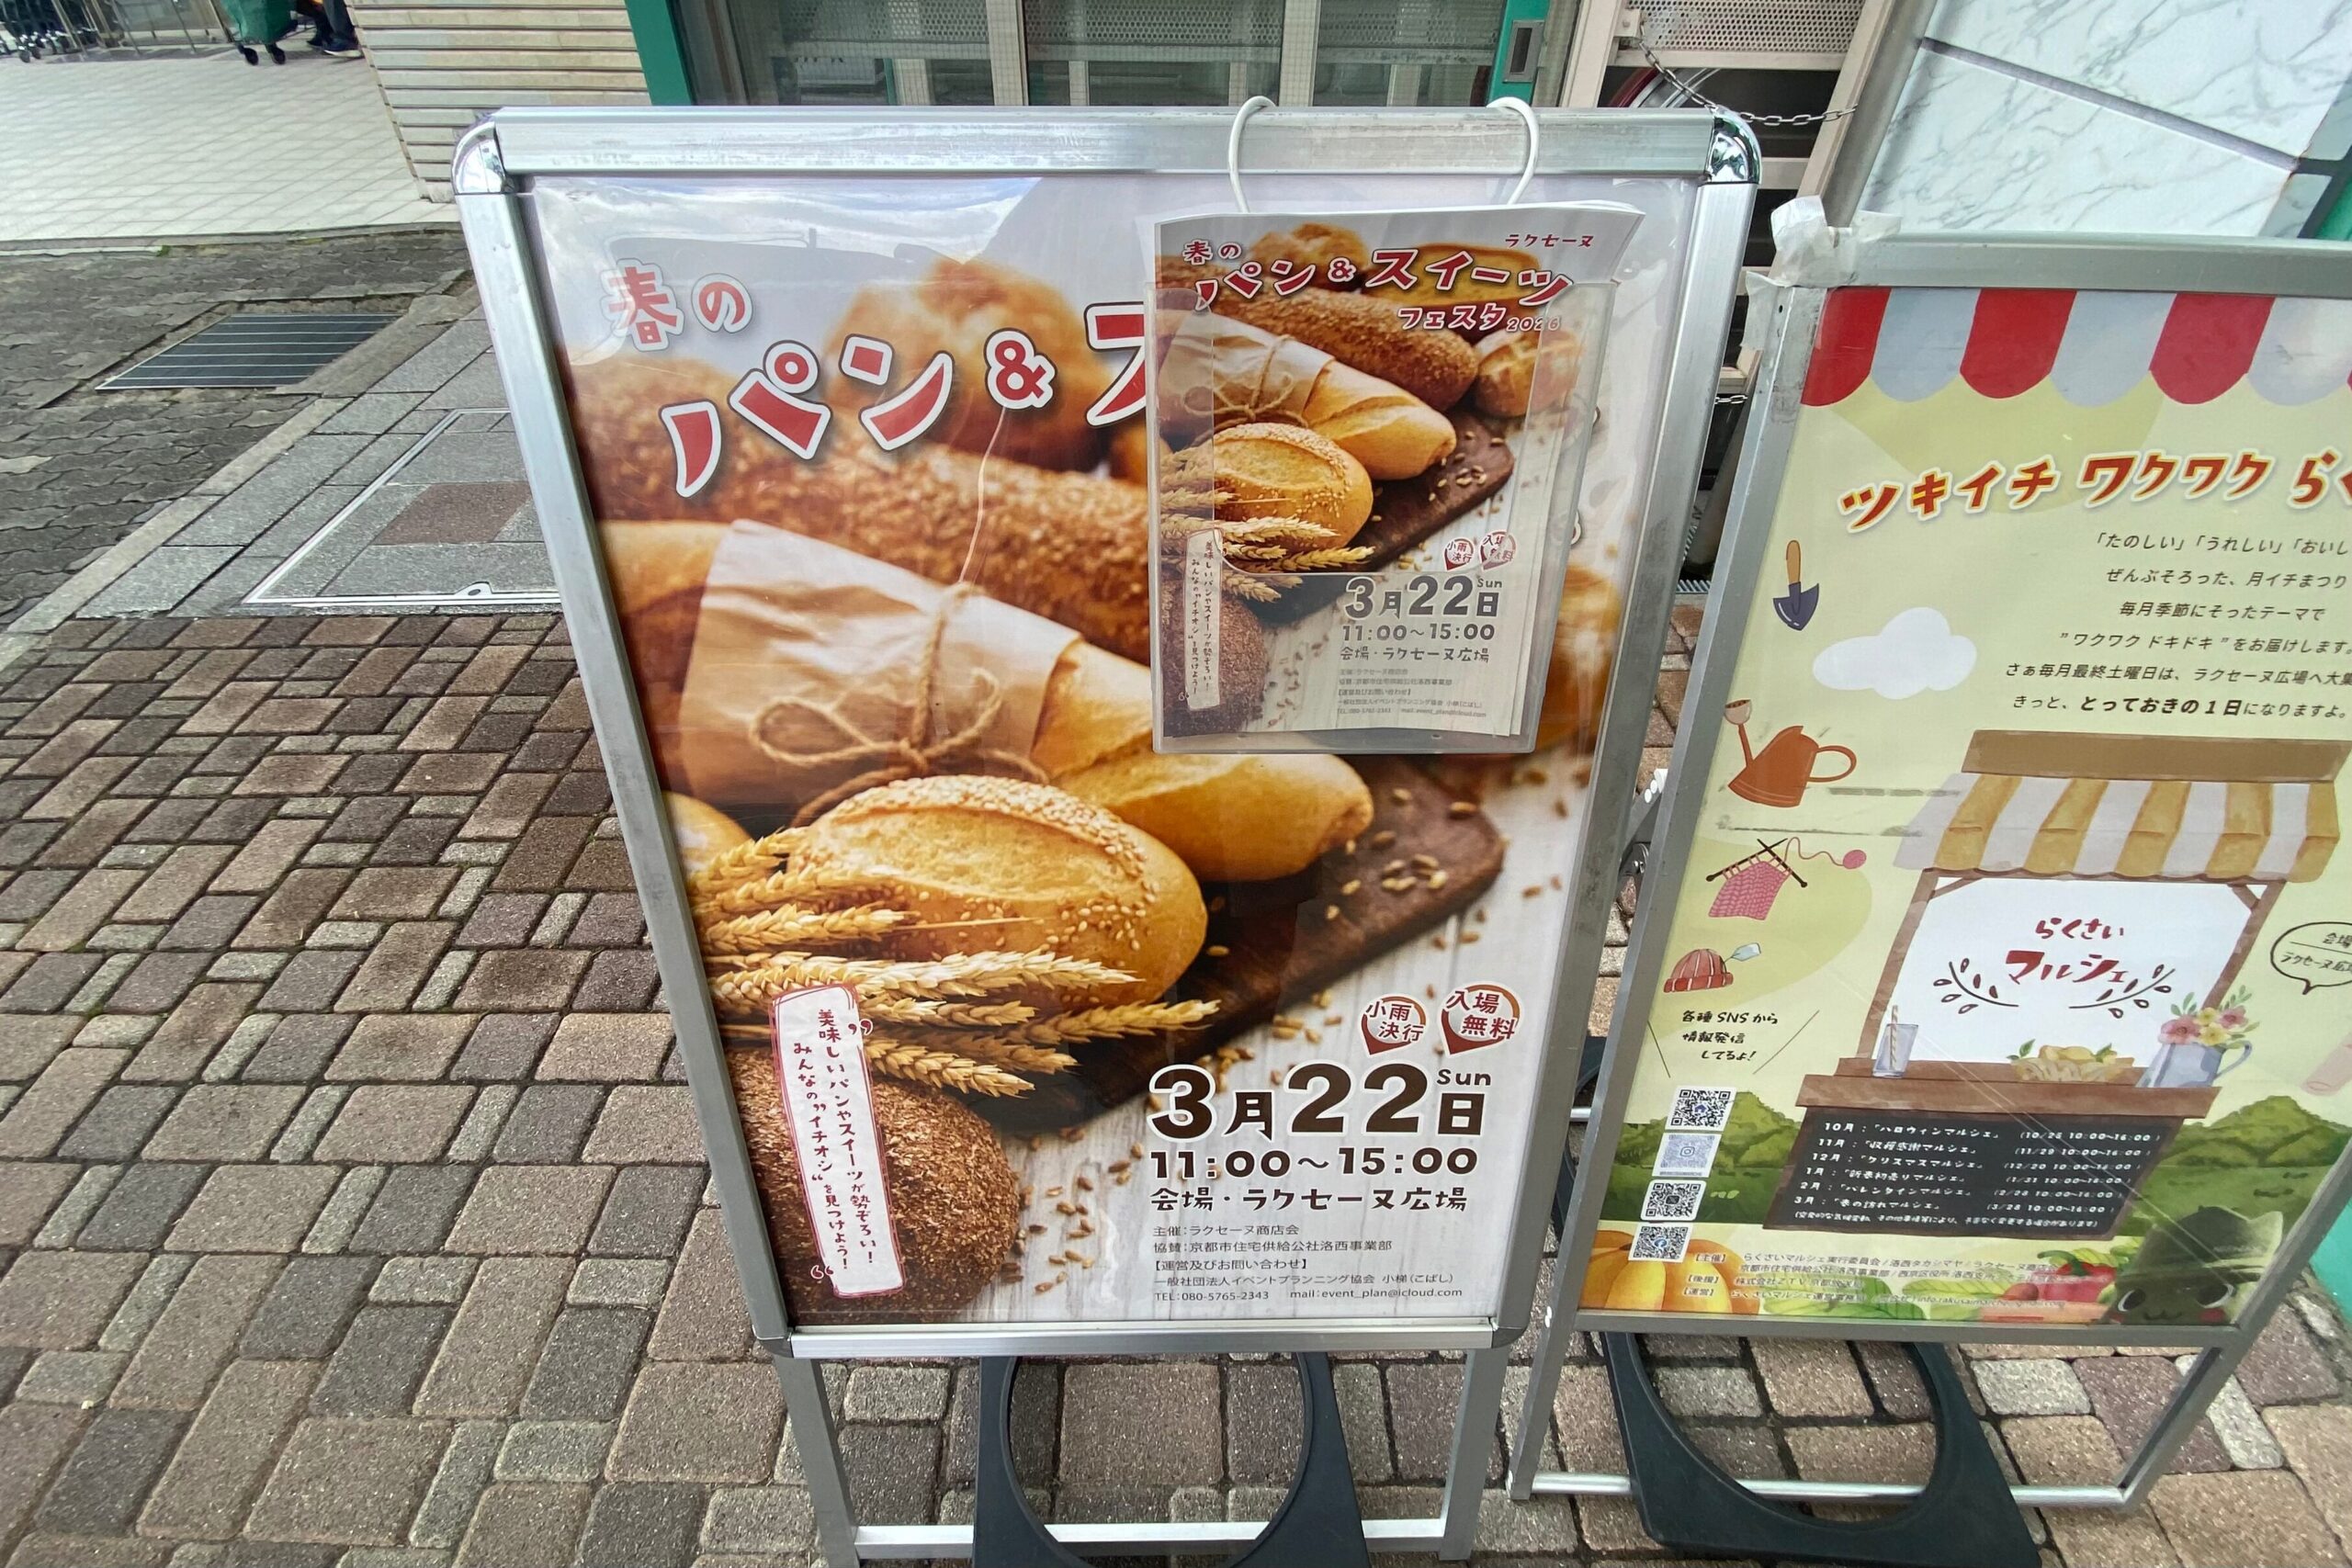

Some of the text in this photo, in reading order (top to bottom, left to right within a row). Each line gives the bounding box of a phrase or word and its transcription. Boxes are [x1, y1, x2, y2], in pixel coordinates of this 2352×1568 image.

[1183, 240, 1241, 265] 春の
[1505, 234, 1594, 247] ラクセーヌ
[603, 260, 752, 351] 春の
[1397, 303, 1506, 331] フェスタ
[1839, 456, 2059, 532] ツキイチ
[2078, 451, 2273, 506] ワクワク
[1477, 578, 1502, 588] Sun
[1345, 575, 1499, 619] 3月22日
[2120, 602, 2326, 621] 毎月季節にそったテーマで
[2035, 918, 2124, 939] らくさい
[2006, 950, 2129, 985] マルシェ
[2280, 952, 2352, 973] ラクセーヌ広
[1366, 1001, 1411, 1021] 小雨
[1446, 990, 1499, 1014] 入場
[1378, 1021, 1424, 1042] 決行
[1461, 1015, 1516, 1039] 無料
[1682, 1031, 1746, 1043] 情報発信
[1436, 1068, 1491, 1086] Sun
[1149, 1062, 1485, 1142] 3月22日
[1150, 1186, 1468, 1212] 会場・ラクセーヌ広場
